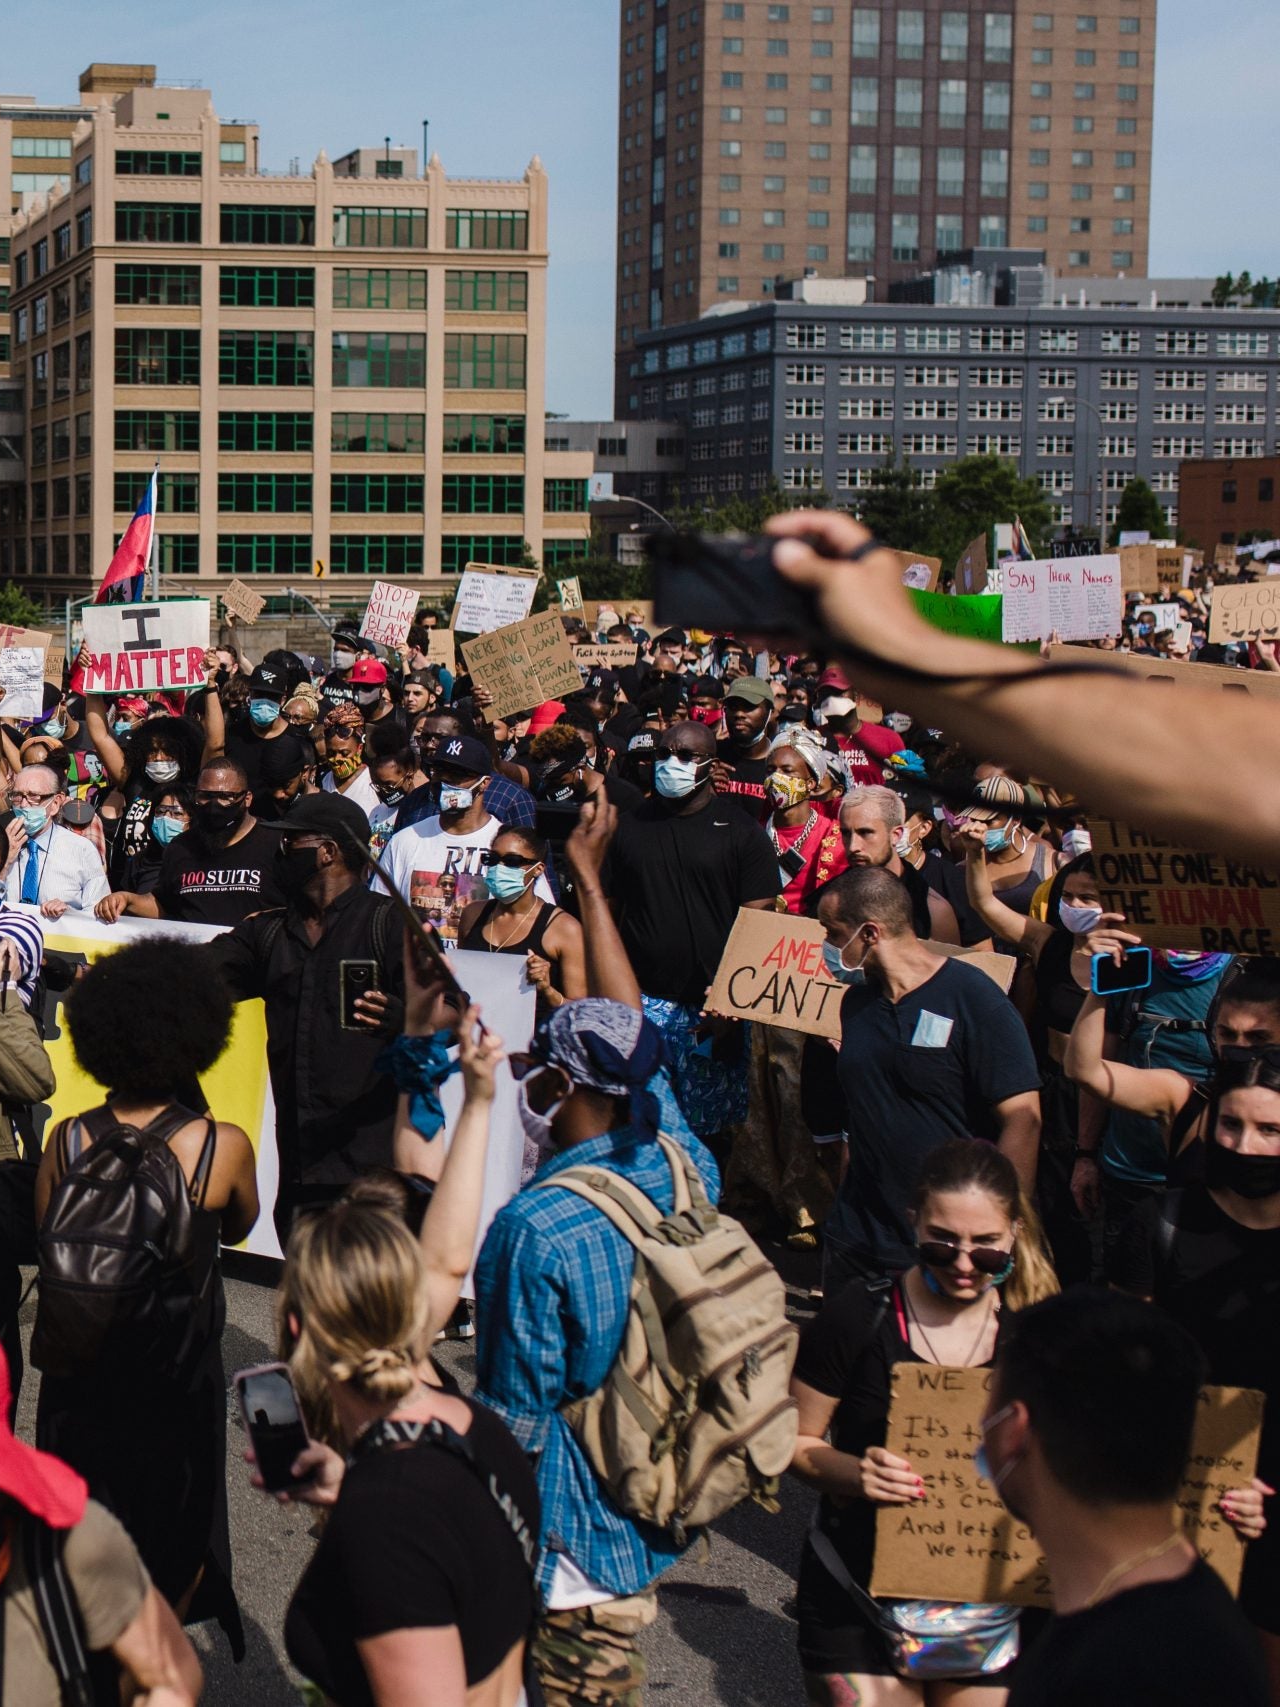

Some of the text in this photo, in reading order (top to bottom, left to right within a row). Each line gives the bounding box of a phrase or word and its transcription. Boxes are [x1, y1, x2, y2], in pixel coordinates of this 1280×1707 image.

[1053, 541, 1096, 559] BLACK
[374, 583, 414, 607] STOP
[368, 600, 414, 625] KILLING
[122, 608, 161, 651] I
[363, 629, 402, 647] PEOPLE
[367, 615, 406, 638] BLACK
[501, 627, 526, 649] NOT
[532, 616, 558, 638] JUST
[474, 632, 561, 680] TEARING DOWN
[86, 646, 206, 691] MATTER
[490, 682, 534, 706] EARING
[495, 675, 581, 717] WHOLE SYSTEM
[1100, 852, 1280, 888] ONLY ONE RAC
[1100, 888, 1265, 927] THE HUMAN
[1201, 927, 1273, 952] RACE
[728, 966, 843, 1021] CAN'T
[918, 1370, 966, 1391] WE
[903, 1415, 949, 1439] It's
[903, 1442, 930, 1459] to
[924, 1471, 965, 1489] et's
[897, 1515, 945, 1536] And
[966, 1543, 1023, 1562] treat
